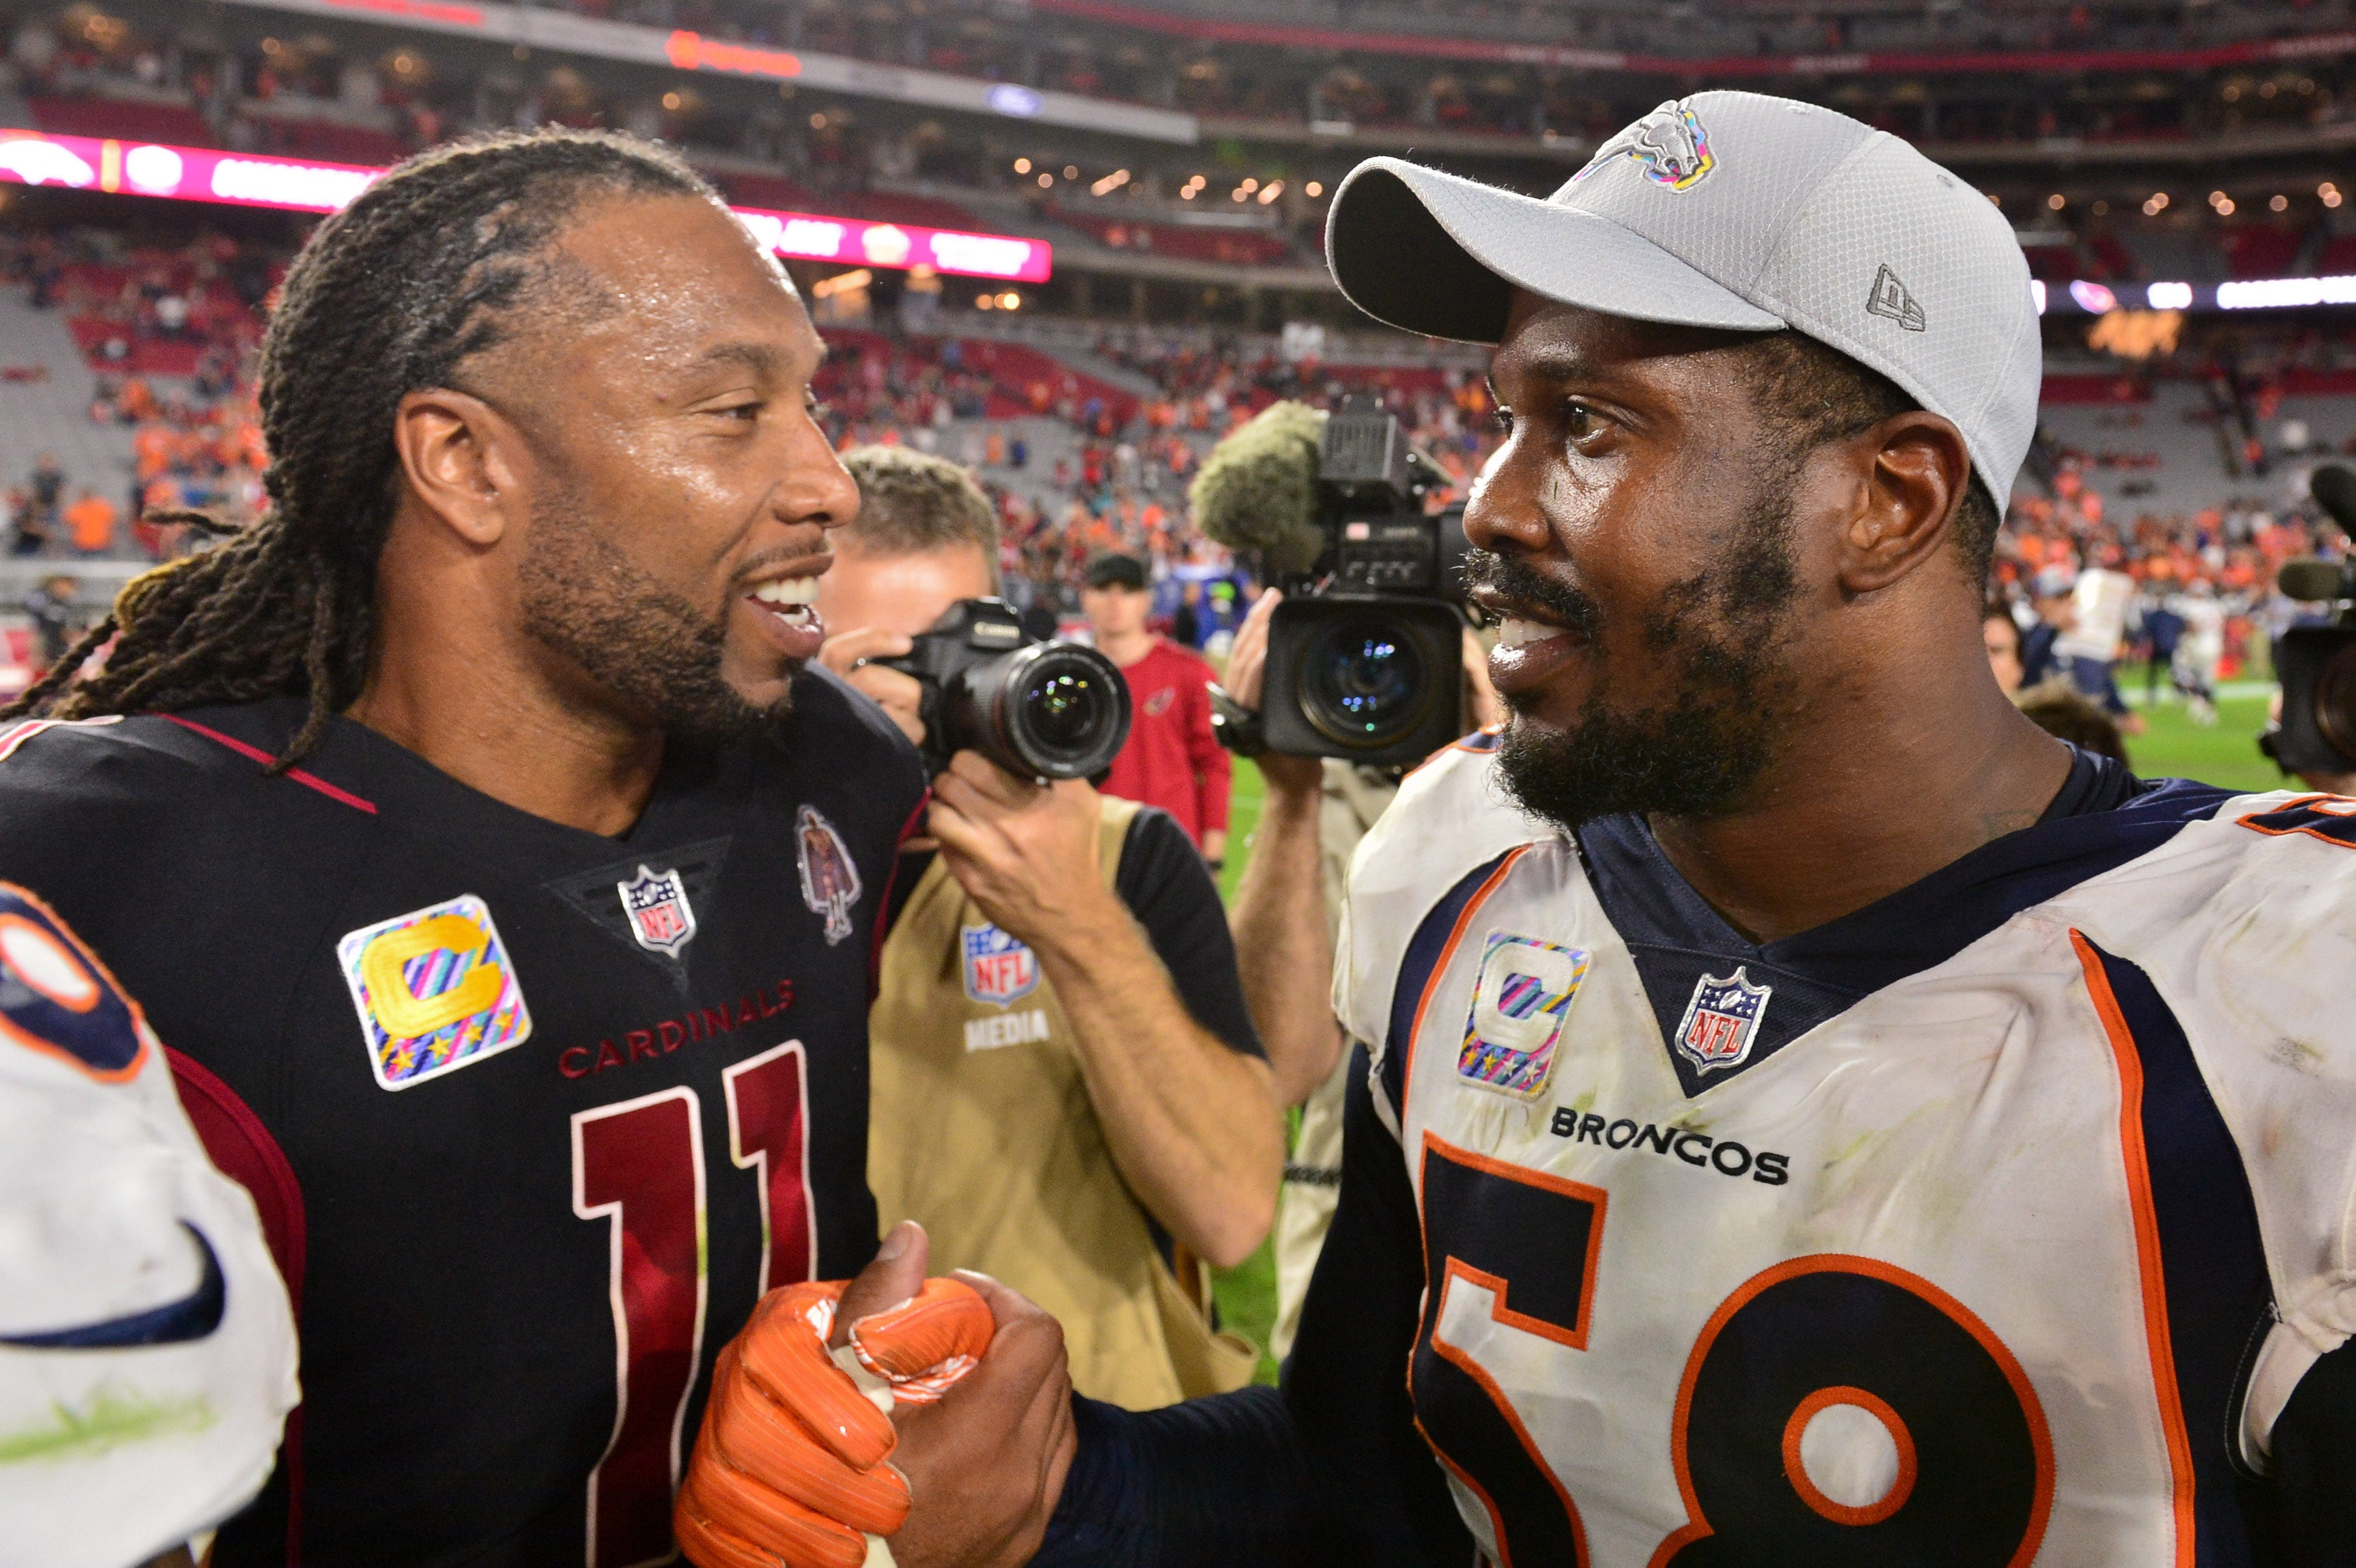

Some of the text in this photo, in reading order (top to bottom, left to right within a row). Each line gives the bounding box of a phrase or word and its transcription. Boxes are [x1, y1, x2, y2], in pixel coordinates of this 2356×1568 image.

[637, 903, 682, 940] NFL
[360, 914, 502, 1039] C
[974, 952, 1030, 989] NFL
[1473, 942, 1575, 1054] C
[558, 979, 797, 1079] CARDINALS
[965, 1009, 1049, 1052] MEDIA
[1689, 1011, 1741, 1057] NFL
[1550, 1106, 1790, 1186] BRONCOS
[571, 1039, 818, 1567] 11
[1406, 1129, 2057, 1568] 58
